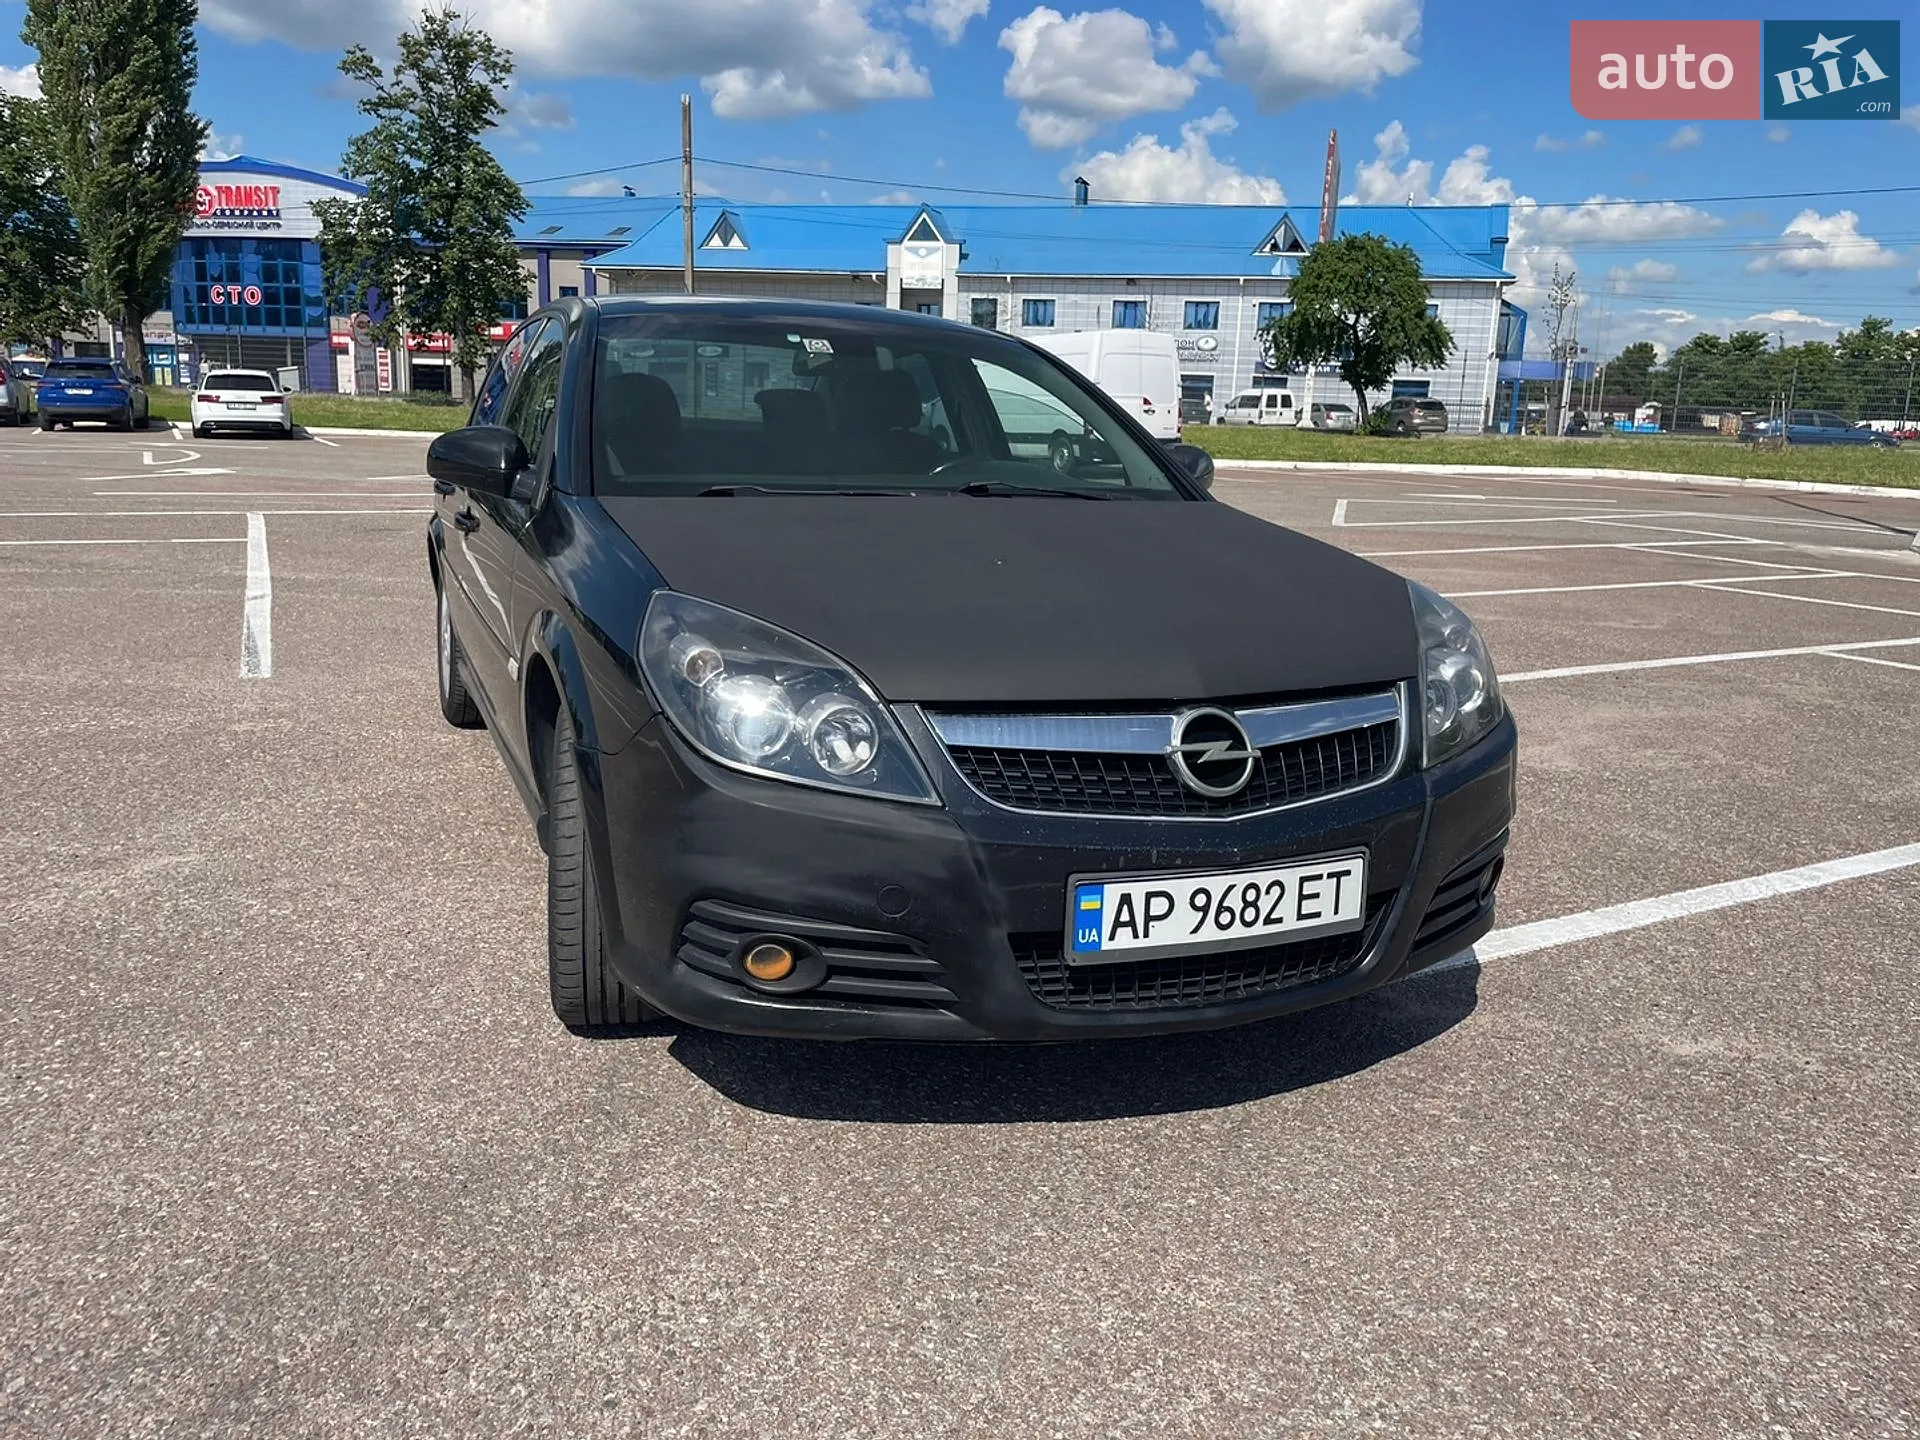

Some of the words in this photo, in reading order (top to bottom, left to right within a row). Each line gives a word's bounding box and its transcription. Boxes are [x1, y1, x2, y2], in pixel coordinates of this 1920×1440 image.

[214, 184, 280, 208] TRANSIT
[215, 208, 279, 217] COMPANY
[210, 284, 262, 306] СТО
[1108, 890, 1175, 942] AP
[1188, 879, 1286, 935] 9682
[1296, 869, 1352, 922] ET
[1078, 927, 1099, 944] UA
